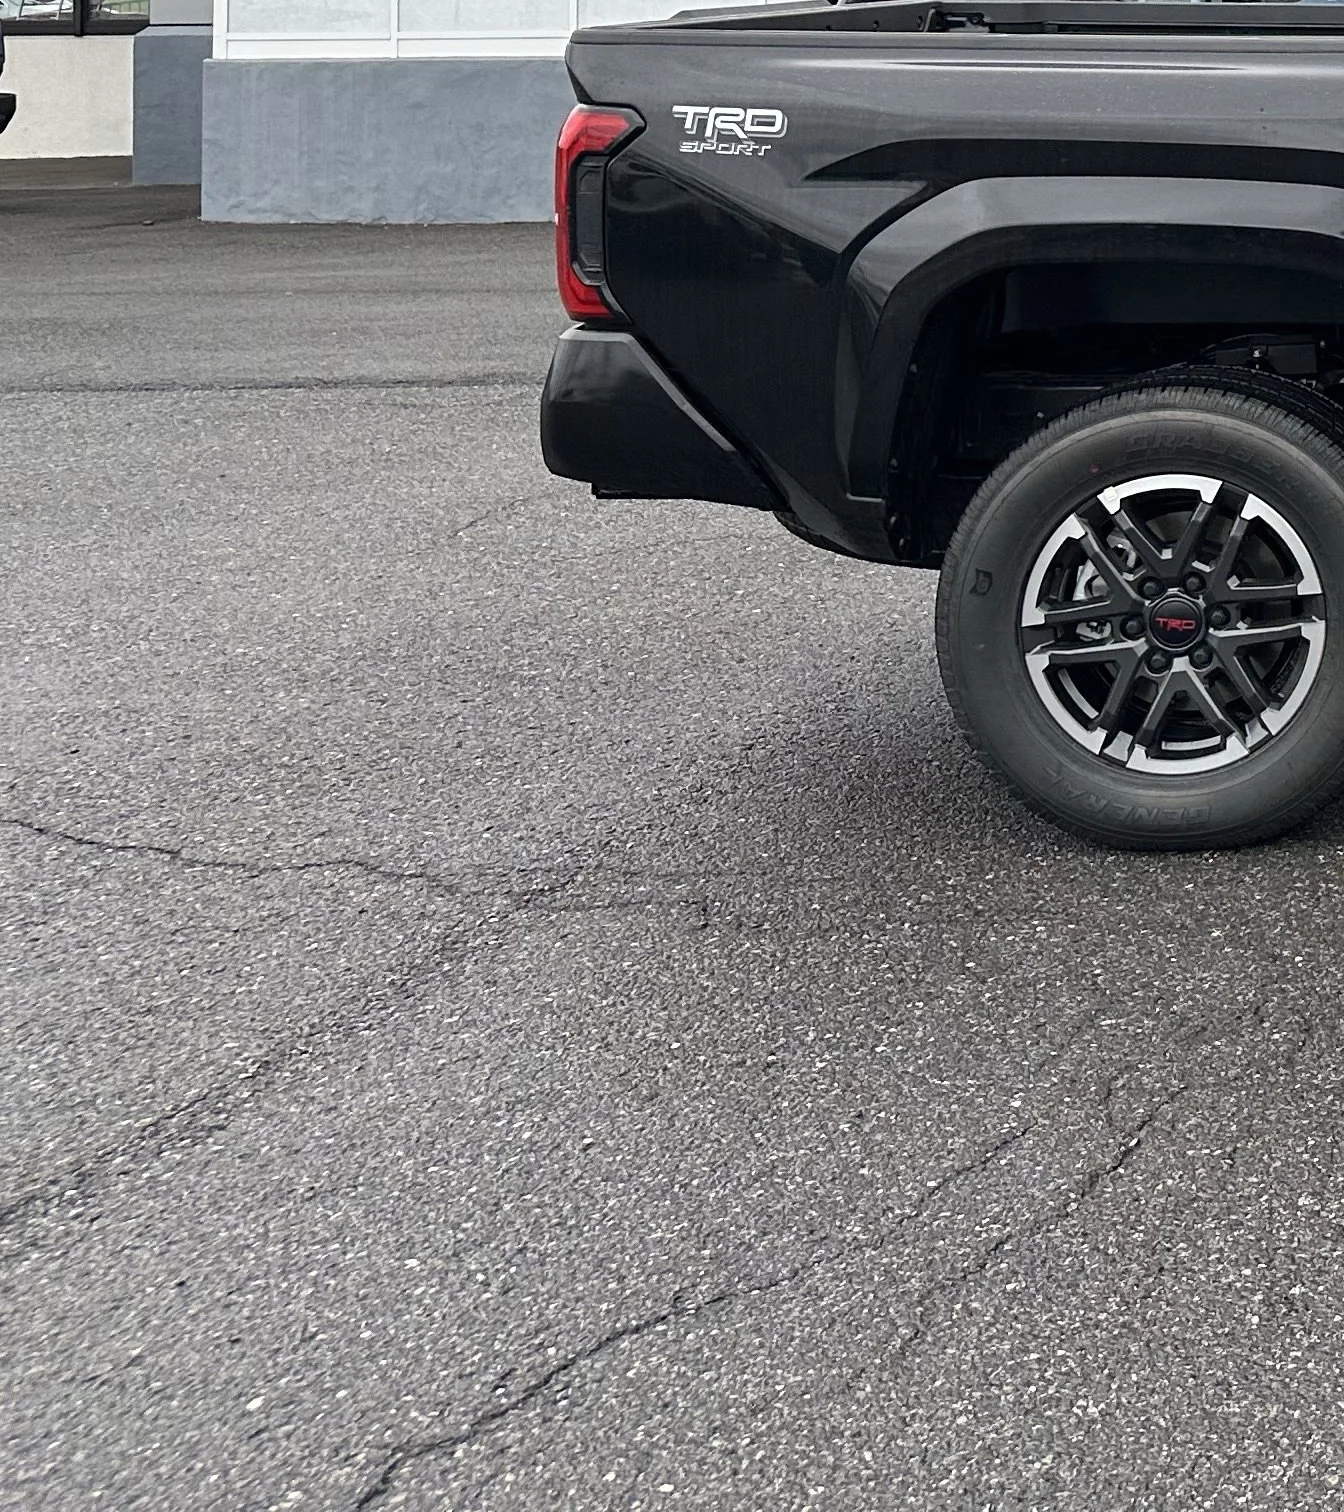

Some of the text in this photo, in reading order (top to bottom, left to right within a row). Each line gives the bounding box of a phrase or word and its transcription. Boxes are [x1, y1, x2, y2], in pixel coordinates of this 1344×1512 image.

[672, 105, 788, 144] TRD
[679, 140, 772, 156] SPORT
[1153, 617, 1196, 632] TRD
[1042, 766, 1213, 828] GENERAL
